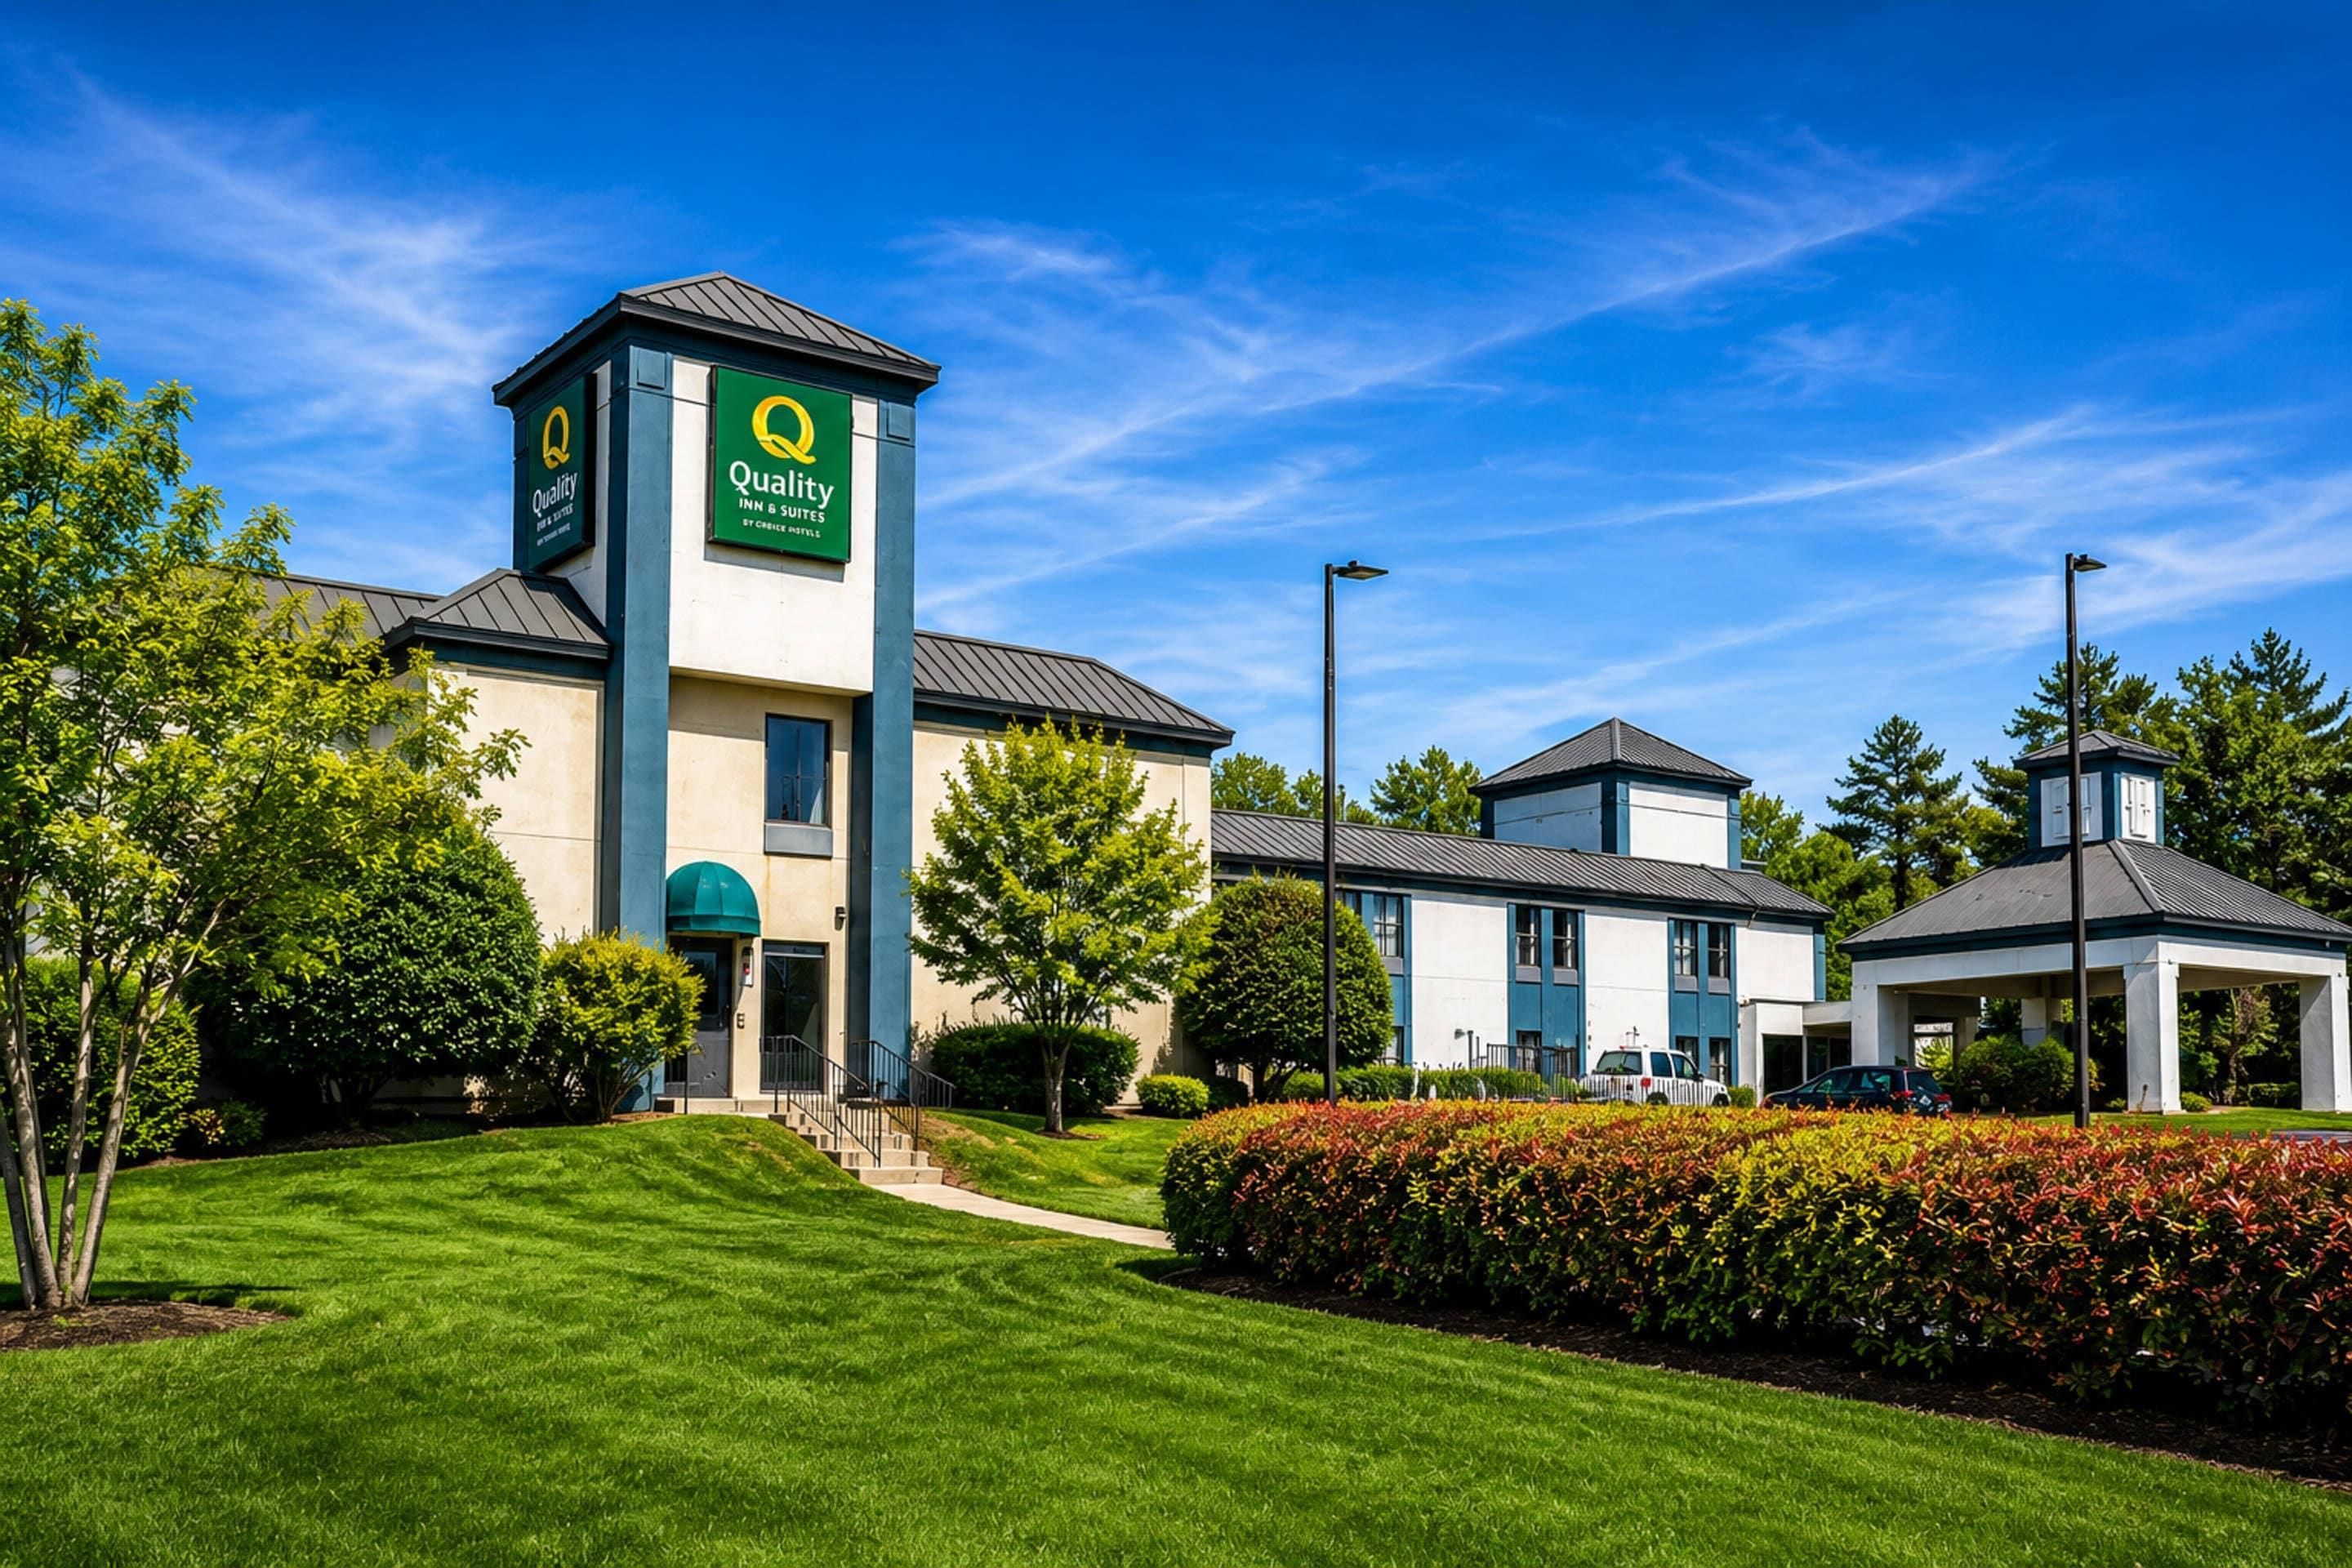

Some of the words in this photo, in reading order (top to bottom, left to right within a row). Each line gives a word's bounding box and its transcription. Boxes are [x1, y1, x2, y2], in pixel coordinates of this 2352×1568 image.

[542, 405, 570, 470] Q
[752, 395, 817, 465] Q
[532, 472, 577, 519] Quality
[729, 461, 835, 510] Quality
[738, 497, 764, 512] INN
[780, 505, 826, 523] SUITES
